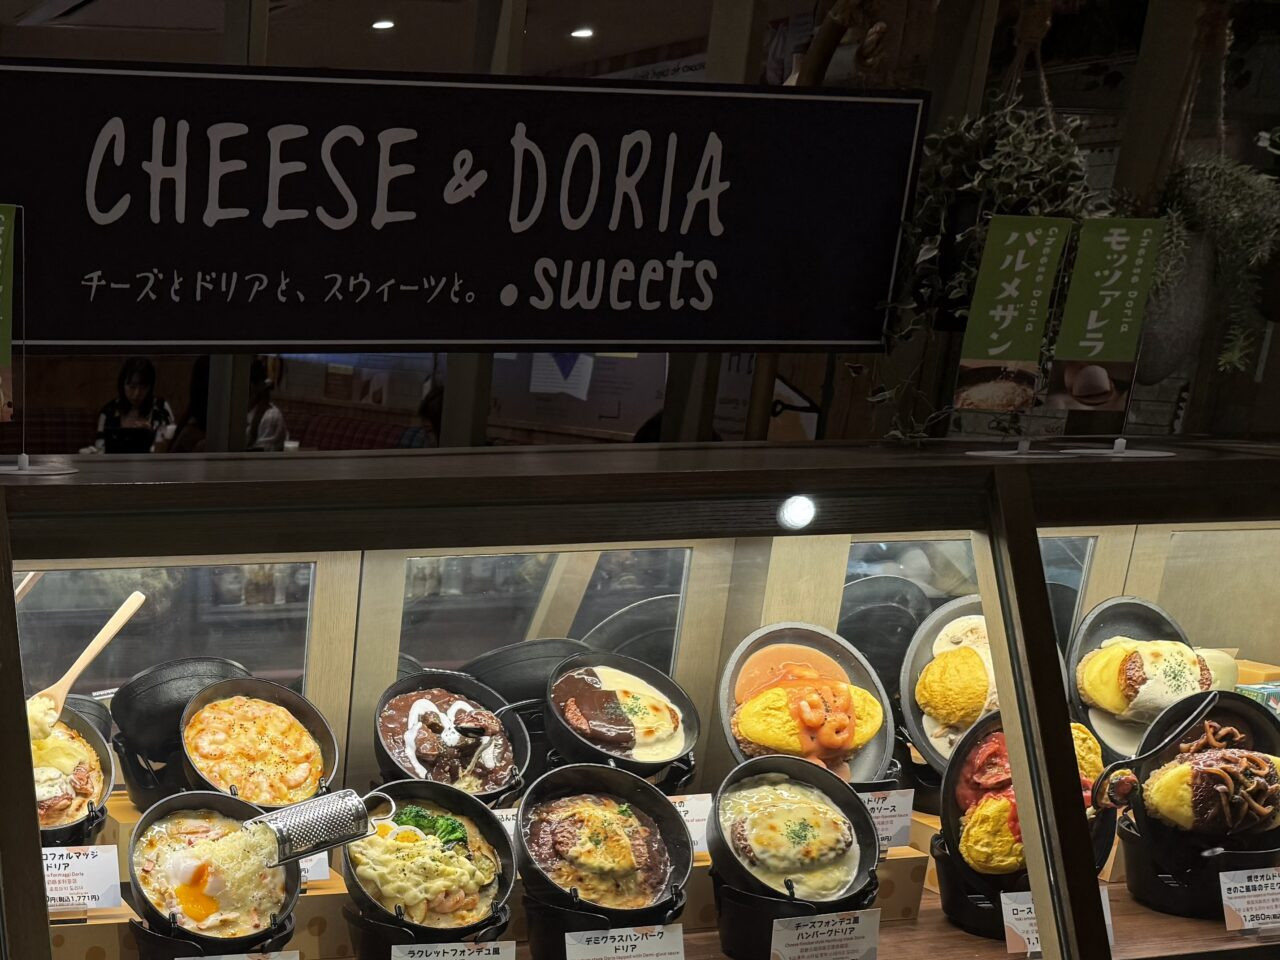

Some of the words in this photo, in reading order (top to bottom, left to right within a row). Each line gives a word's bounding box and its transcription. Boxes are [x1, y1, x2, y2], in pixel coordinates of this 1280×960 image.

[86, 116, 418, 230] CHEESE
[443, 149, 488, 204] &
[508, 122, 730, 236] DORIA
[1035, 227, 1058, 283] Cheese
[1131, 228, 1153, 285] Cheese
[81, 268, 476, 304] チーズとドリアと、スウィーツと。
[987, 228, 1042, 356] パルメザン
[1078, 228, 1131, 357] モッツァレラ
[1025, 289, 1042, 333] Doria
[1120, 291, 1138, 333] Doria
[46, 863, 69, 871] ドリア
[408, 947, 500, 958] ラクレットフォンデュ風
[614, 945, 637, 953] ドリア
